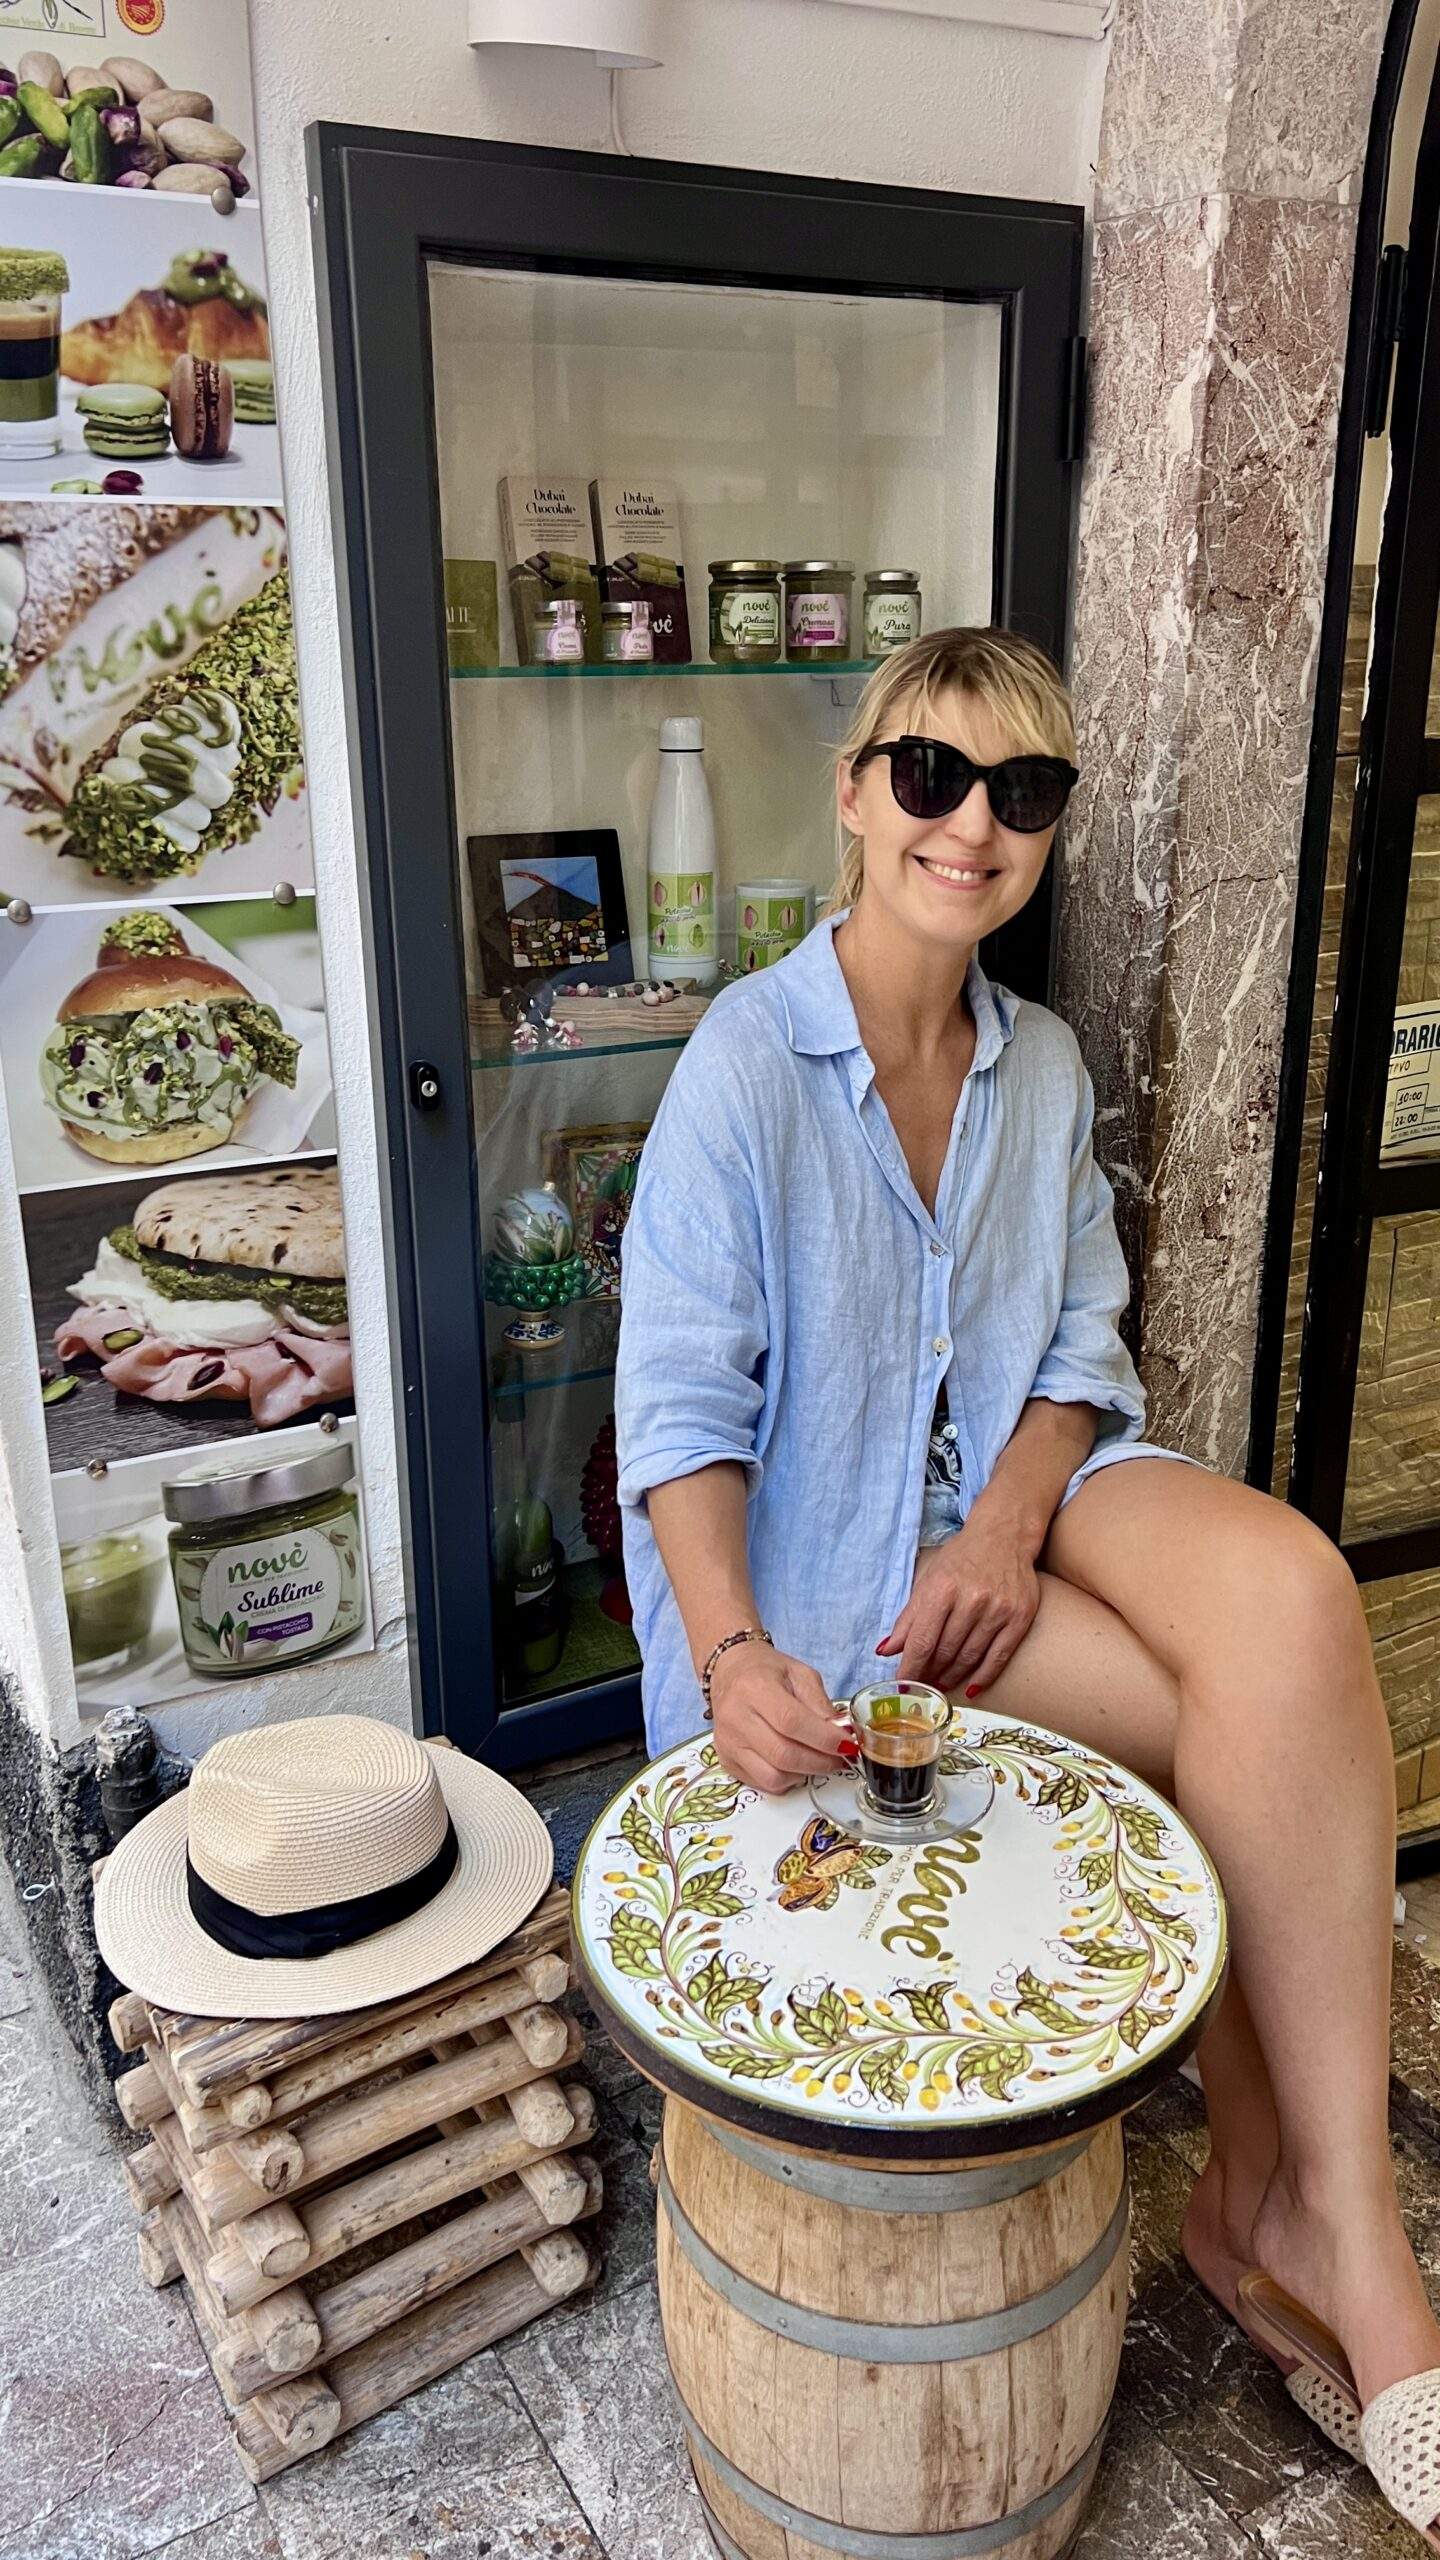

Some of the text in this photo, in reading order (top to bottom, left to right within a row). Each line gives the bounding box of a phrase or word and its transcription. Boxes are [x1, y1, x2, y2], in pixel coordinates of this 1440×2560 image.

[533, 488, 565, 501] Dubai
[526, 502, 576, 514] Chocolate
[615, 504, 664, 516] Chocolate
[652, 614, 673, 634] vè
[1391, 1023, 1440, 1055] RARI
[237, 1580, 325, 1613] Sublime
